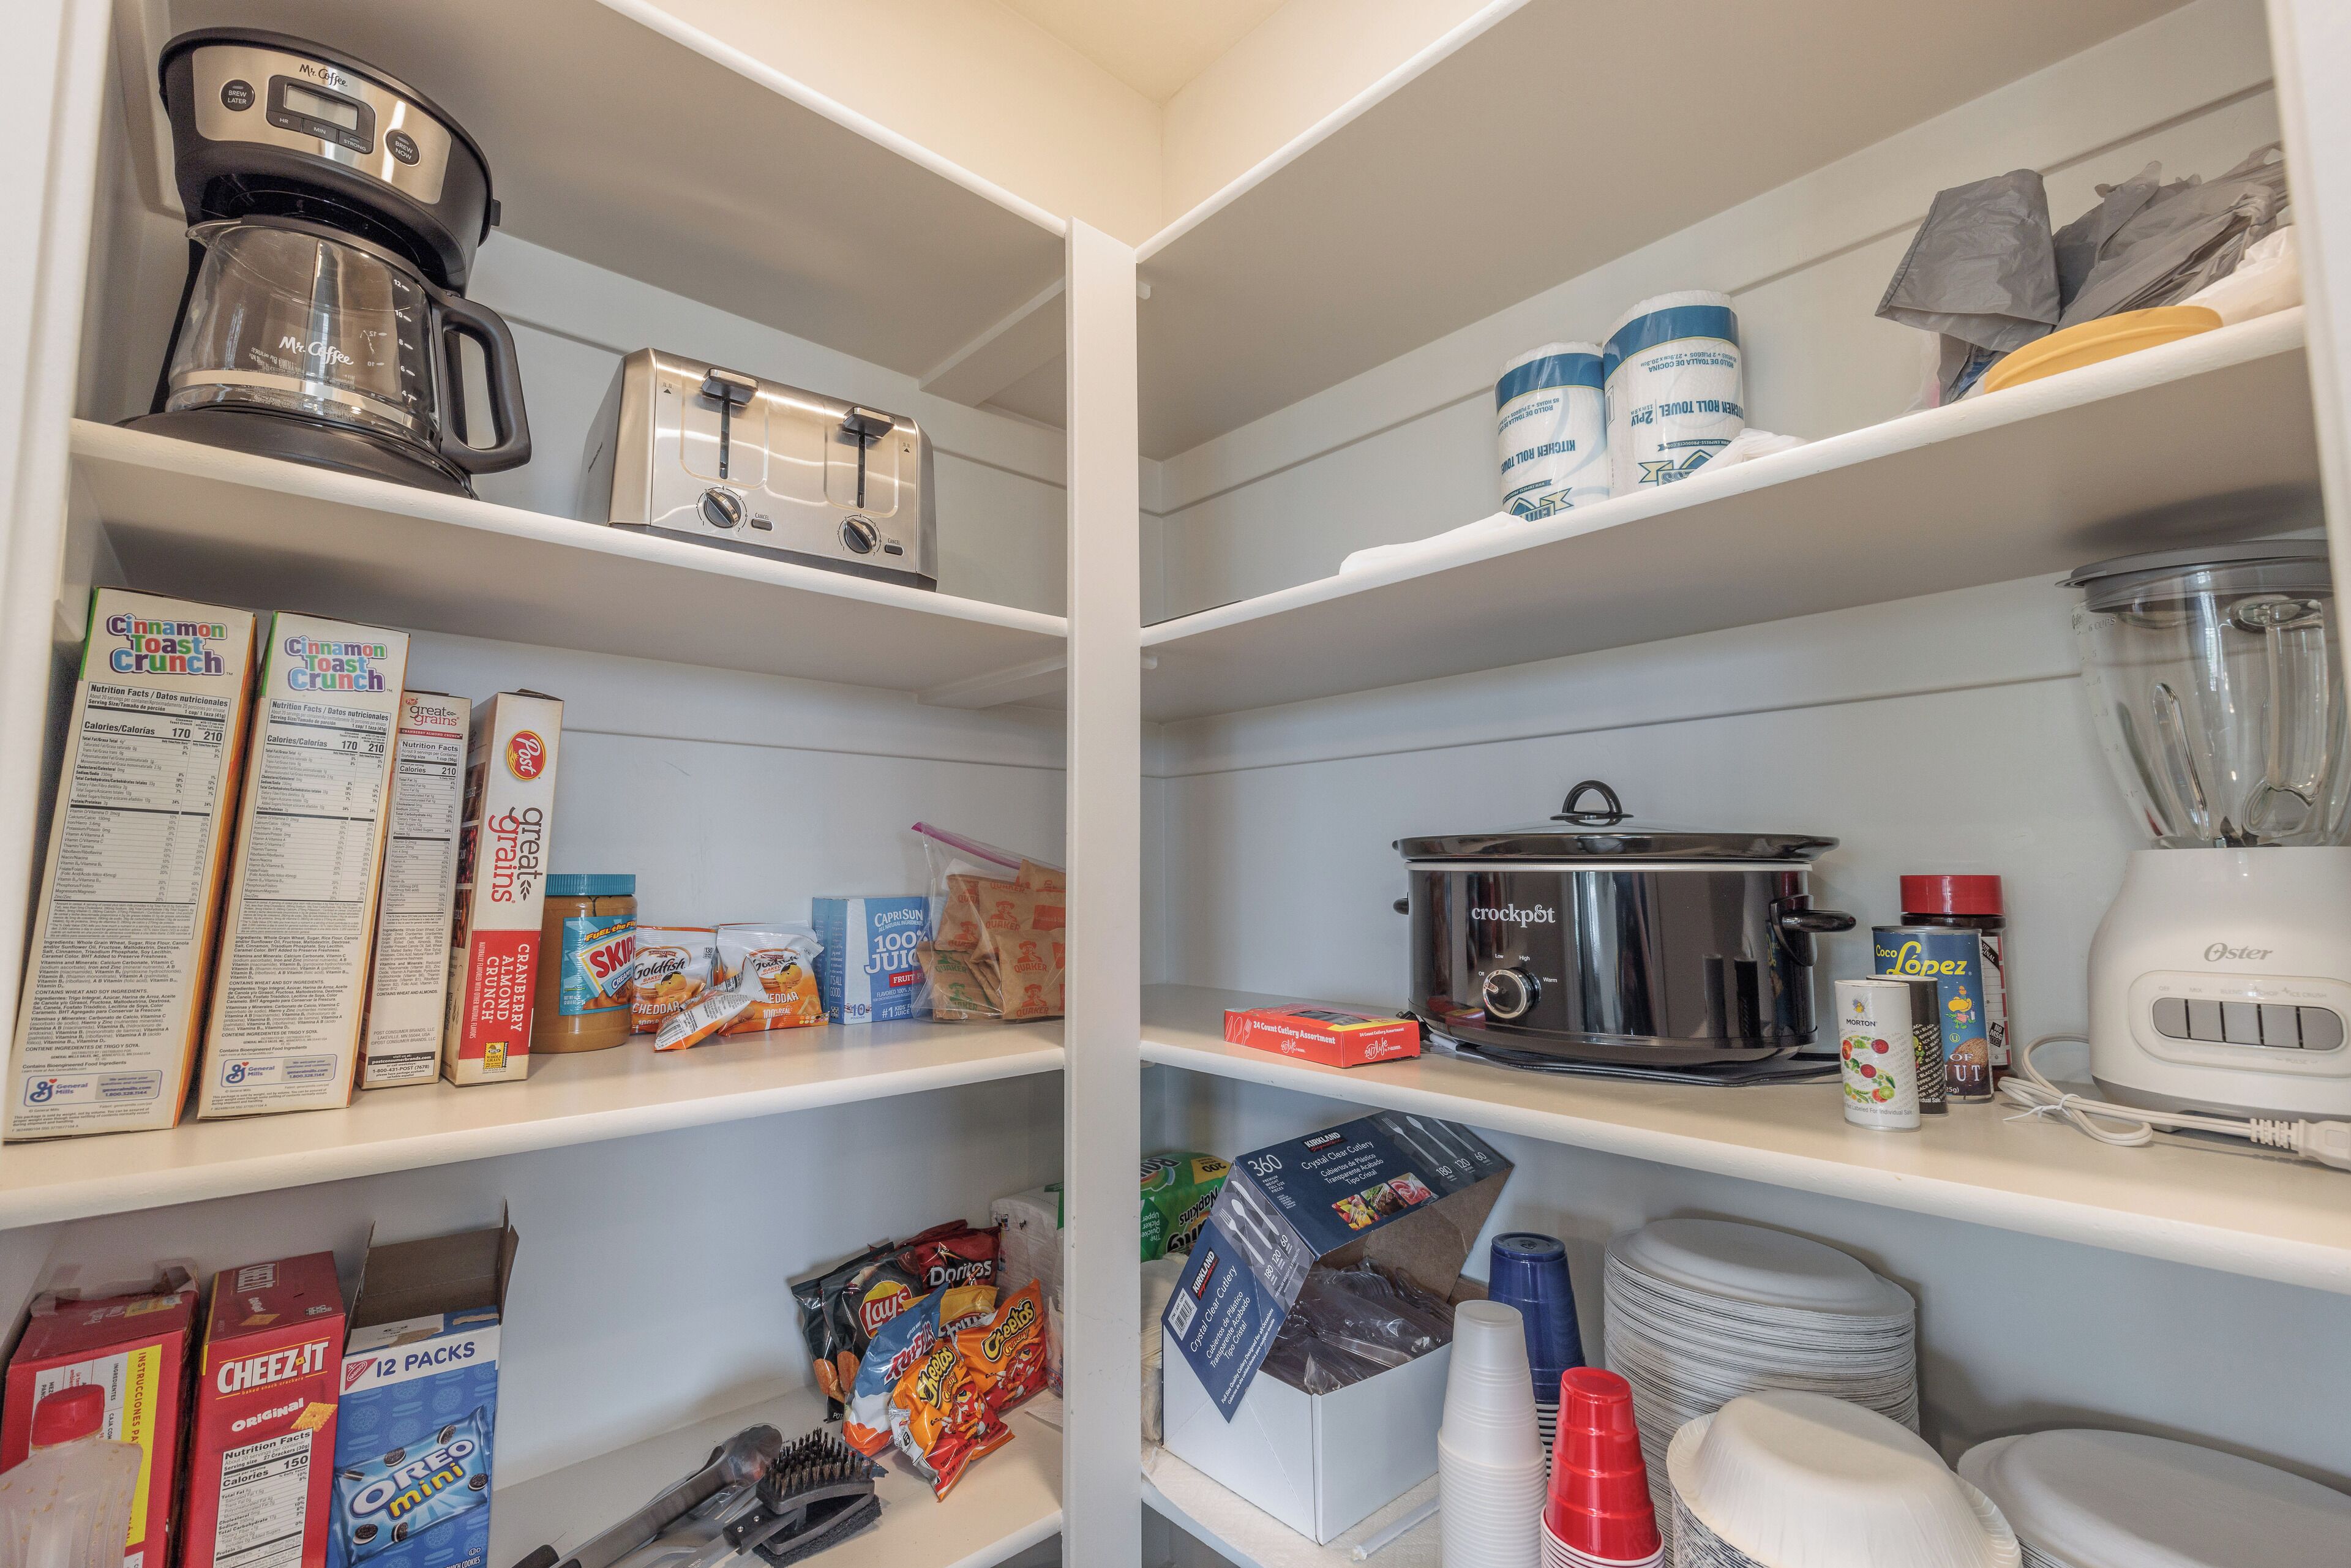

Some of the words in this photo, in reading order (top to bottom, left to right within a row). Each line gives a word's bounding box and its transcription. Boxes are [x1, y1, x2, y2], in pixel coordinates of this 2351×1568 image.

[299, 64, 317, 77] Mr.
[318, 69, 348, 86] Coffee
[343, 139, 366, 151] STRONG
[395, 141, 413, 154] BREW
[395, 148, 411, 160] NOW
[279, 337, 305, 354] Mr.
[308, 341, 354, 364] Coffee
[1649, 362, 1674, 372] COCINA
[1721, 359, 1734, 368] ROLLO
[1659, 401, 1694, 417] TOWEL
[1697, 400, 1719, 412] ROLL
[1631, 411, 1653, 427] 2PLY
[1516, 448, 1534, 465] ROLL
[1537, 440, 1575, 457] KITCHEN
[111, 615, 223, 637] Cinnamon
[131, 634, 203, 655] Toast
[289, 637, 384, 657] Cinnamon
[114, 650, 222, 673] Crunch
[306, 655, 367, 673] Toast
[291, 669, 383, 690] Crunch
[91, 685, 125, 694] Nutrition
[127, 689, 149, 697] Facts
[156, 692, 178, 700] Datos
[180, 696, 228, 707] nutricionales
[272, 701, 301, 711] Nutrition
[348, 711, 388, 721] nutricionales
[410, 705, 446, 718] great
[84, 722, 155, 735] Calories/Calorías
[414, 715, 457, 726] grains
[172, 728, 190, 738] 170
[204, 732, 222, 741] 210
[268, 735, 328, 747] Calories/Calorías
[342, 740, 358, 750] 170
[369, 744, 384, 752] 210
[516, 738, 541, 775] Post
[509, 806, 543, 880] great
[488, 814, 519, 902] grains
[1472, 904, 1556, 928] crockpot
[986, 921, 1020, 931] QUAKER
[864, 948, 920, 974] JUIC
[1876, 945, 1897, 958] Coco
[1887, 941, 1968, 976] López
[2204, 943, 2273, 961] Oster
[635, 958, 685, 980] Goldfish
[1013, 963, 1047, 973] QUAKER
[497, 955, 514, 1021] ALMOND
[511, 943, 530, 1032] CRANBERRY
[893, 975, 913, 983] FRUIT
[632, 1002, 680, 1015] CHEDDAR
[852, 1003, 866, 1016] 10
[1016, 1007, 1049, 1018] QUAKER
[1261, 1022, 1277, 1031] Count
[1278, 1026, 1299, 1038] Cutlery
[1300, 1031, 1335, 1044] Assortment
[1990, 1030, 2002, 1040] MSG
[372, 1056, 431, 1065] postconsumerbrands.com
[1851, 1104, 1868, 1112] Labeled
[1304, 1132, 1341, 1148] KIRKLAND
[1302, 1156, 1327, 1169] Crystal
[1328, 1150, 1347, 1160] Clear
[1347, 1141, 1374, 1153] Cutlery
[1455, 1158, 1470, 1169] 120
[1474, 1152, 1487, 1160] 60
[1202, 1163, 1226, 1172] 200
[1248, 1154, 1282, 1176] 360
[1321, 1165, 1348, 1177] Cubiertos
[1356, 1153, 1376, 1163] Plástico
[1436, 1166, 1452, 1176] 180
[1179, 1186, 1218, 1226] Napkins
[1142, 1220, 1160, 1229] Picker
[931, 1261, 992, 1286] Doritos
[1193, 1251, 1215, 1293] KIRKLAND
[864, 1291, 907, 1330] Lay's
[1190, 1324, 1209, 1352] Crystal
[1205, 1299, 1220, 1322] Clear
[1217, 1266, 1238, 1299] Cutlery
[984, 1302, 1034, 1359] Cheetos
[376, 1358, 396, 1378] 12
[405, 1341, 475, 1371] PACKS
[348, 1362, 366, 1380] NABISCO
[918, 1346, 956, 1409] Cheetos
[132, 1352, 146, 1427] INSTRUCCIONES
[279, 1377, 304, 1386] crackers
[225, 1441, 276, 1460] Nutrition
[280, 1431, 311, 1444] Facts
[283, 1455, 308, 1469] 150
[223, 1469, 269, 1487] Calories
[351, 1441, 473, 1515] OREO
[389, 1463, 463, 1518] mini
